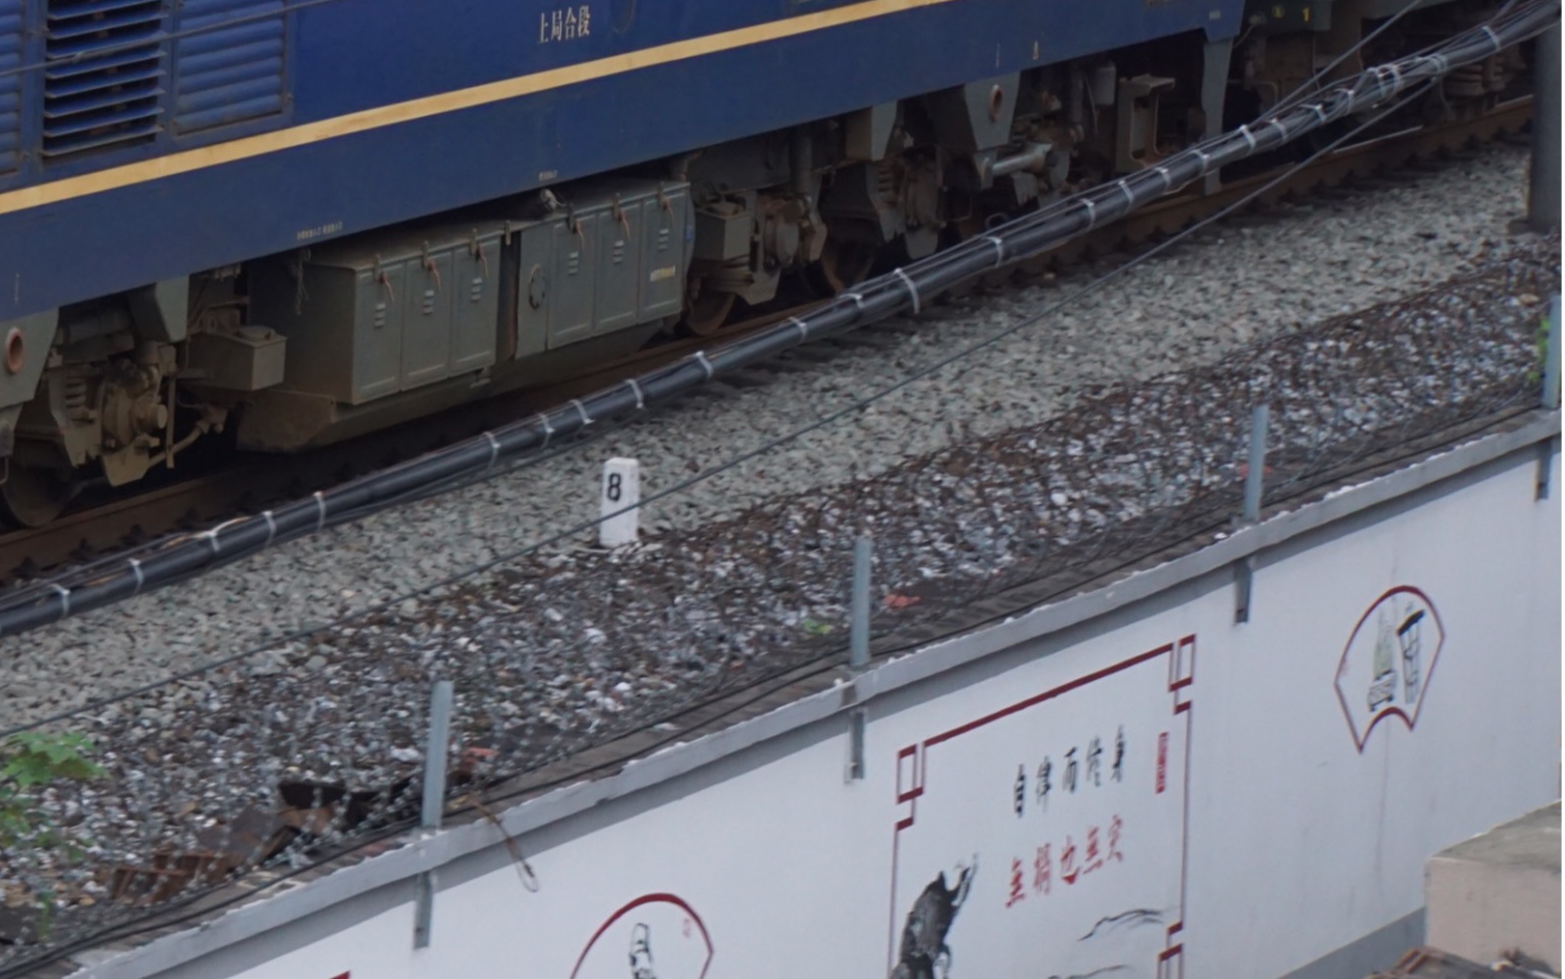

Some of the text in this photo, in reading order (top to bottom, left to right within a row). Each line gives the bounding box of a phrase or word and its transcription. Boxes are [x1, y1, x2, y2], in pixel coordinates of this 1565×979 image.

[538, 5, 590, 43] 上局合段
[607, 473, 622, 502] 8
